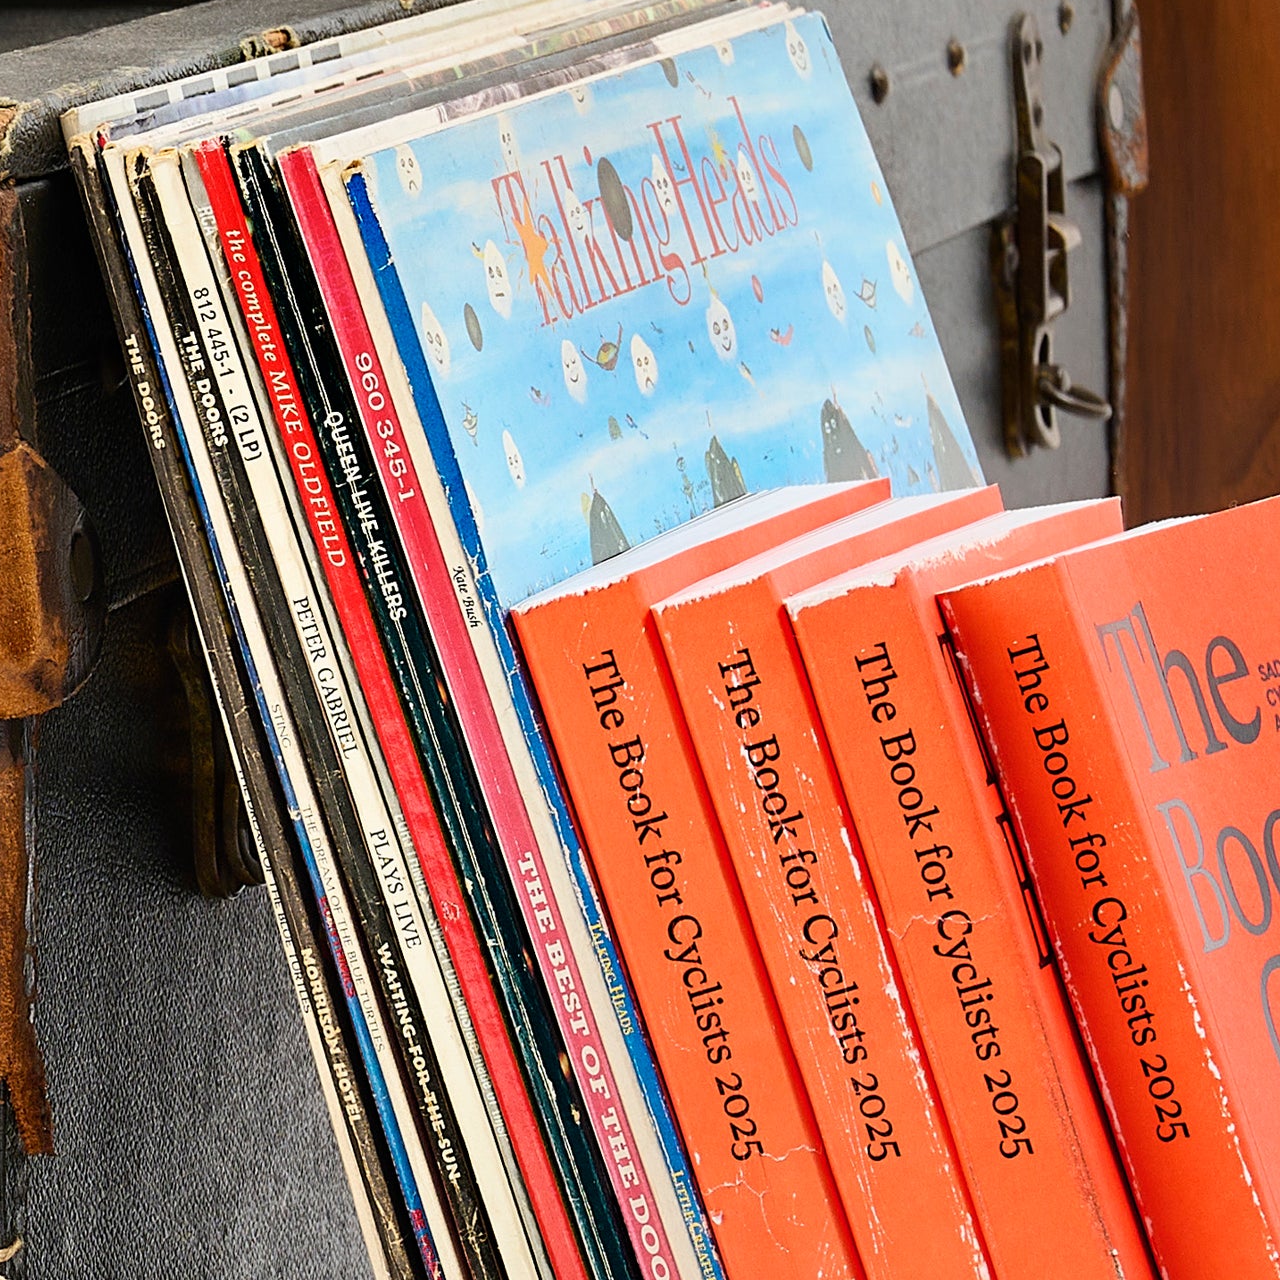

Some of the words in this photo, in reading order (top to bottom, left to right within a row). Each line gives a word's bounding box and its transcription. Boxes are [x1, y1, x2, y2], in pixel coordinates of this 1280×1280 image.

[647, 95, 799, 267] Heads
[193, 287, 218, 323] 812
[207, 328, 235, 377] 445-1
[125, 333, 146, 375] THE
[137, 381, 166, 450] DOORS
[182, 331, 206, 372] THE
[196, 377, 230, 447] DOORS
[225, 229, 247, 263] the
[238, 270, 277, 362] complete
[269, 370, 304, 435] MIKE
[292, 443, 347, 568] OLDFIELD
[229, 404, 251, 425] (2
[355, 352, 386, 411] 960
[377, 419, 417, 502] 345-1
[239, 429, 262, 462] LP)
[323, 410, 363, 483] QUEEN
[351, 489, 380, 537] LIVE
[368, 540, 408, 622] KILLERS
[452, 565, 469, 598] Kate
[461, 596, 484, 629] Bush
[293, 596, 328, 664] PETER
[317, 668, 360, 760] GABRIEL
[583, 649, 625, 730] The
[718, 648, 761, 729] The
[855, 641, 899, 724] The
[1007, 634, 1050, 715] The
[1096, 601, 1263, 773] The
[608, 734, 669, 846] Book
[744, 733, 804, 846] Book
[880, 728, 941, 840] Book
[1033, 718, 1093, 828] Book
[271, 703, 292, 749] STING
[302, 806, 319, 835] THE
[312, 837, 336, 893] DREAM
[330, 894, 342, 914] OF
[337, 921, 354, 949] THE
[348, 951, 368, 986] BLUE
[360, 989, 386, 1054] TURTLES
[370, 828, 404, 896] PLAYS
[394, 899, 423, 949] LIVE
[645, 849, 685, 908] for
[780, 848, 820, 908] for
[914, 842, 955, 903] for
[1068, 832, 1109, 889] for
[301, 947, 342, 1056] MORRISON
[517, 851, 556, 934] THE
[545, 939, 591, 1037] BEST
[581, 1045, 611, 1100] OF
[600, 1107, 640, 1189] THE
[664, 913, 733, 1066] Cyclists
[799, 913, 868, 1066] Cyclists
[932, 909, 1001, 1062] Cyclists
[1088, 896, 1157, 1048] Cyclists
[377, 942, 417, 1041] WAITING
[408, 1043, 431, 1084] FOR
[424, 1091, 448, 1132] THE
[437, 1137, 461, 1183] SUN
[714, 1072, 764, 1162] 2025
[850, 1073, 901, 1162] 2025
[984, 1069, 1034, 1160] 2025
[1140, 1053, 1191, 1143] 2025
